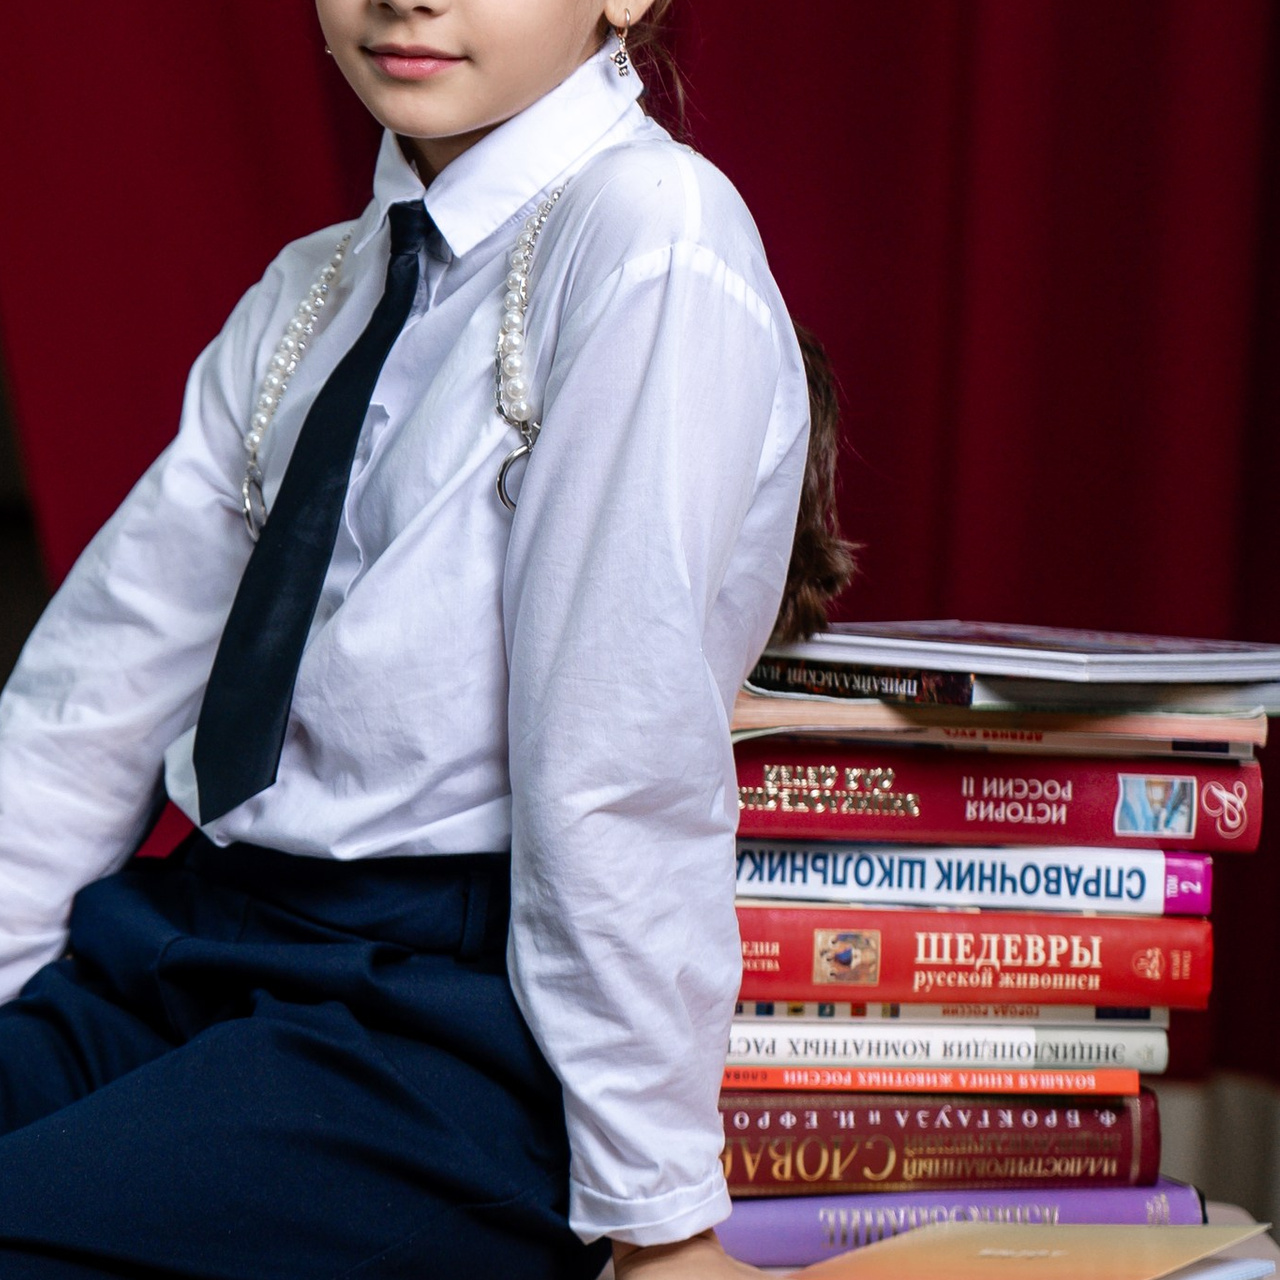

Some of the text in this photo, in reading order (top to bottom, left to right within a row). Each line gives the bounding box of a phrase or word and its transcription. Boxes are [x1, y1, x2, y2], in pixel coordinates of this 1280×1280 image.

[787, 667, 919, 697] ПРИБАЙКАЛЬСКИЙ
[982, 776, 1073, 802] РОССИИ
[965, 800, 1068, 825] ИСТОРИЯ
[935, 858, 1147, 900] СПРАВОЧНИК
[1180, 880, 1203, 895] 2
[915, 932, 1102, 970] ШЕДЕВРЫ
[913, 968, 1101, 992] русской живописи
[789, 1038, 931, 1058] КОМНАТНЫХ
[943, 1039, 1126, 1064] ЭНЦИКЛОПЕДИЯ
[783, 1070, 852, 1086] РОССИИ
[857, 1070, 953, 1088] ЖИВОТНЫХ
[959, 1072, 1013, 1089] КНИГА
[1019, 1073, 1096, 1091] БОЛЬШАЯ
[895, 1104, 1081, 1129] БРОКГАУЗА
